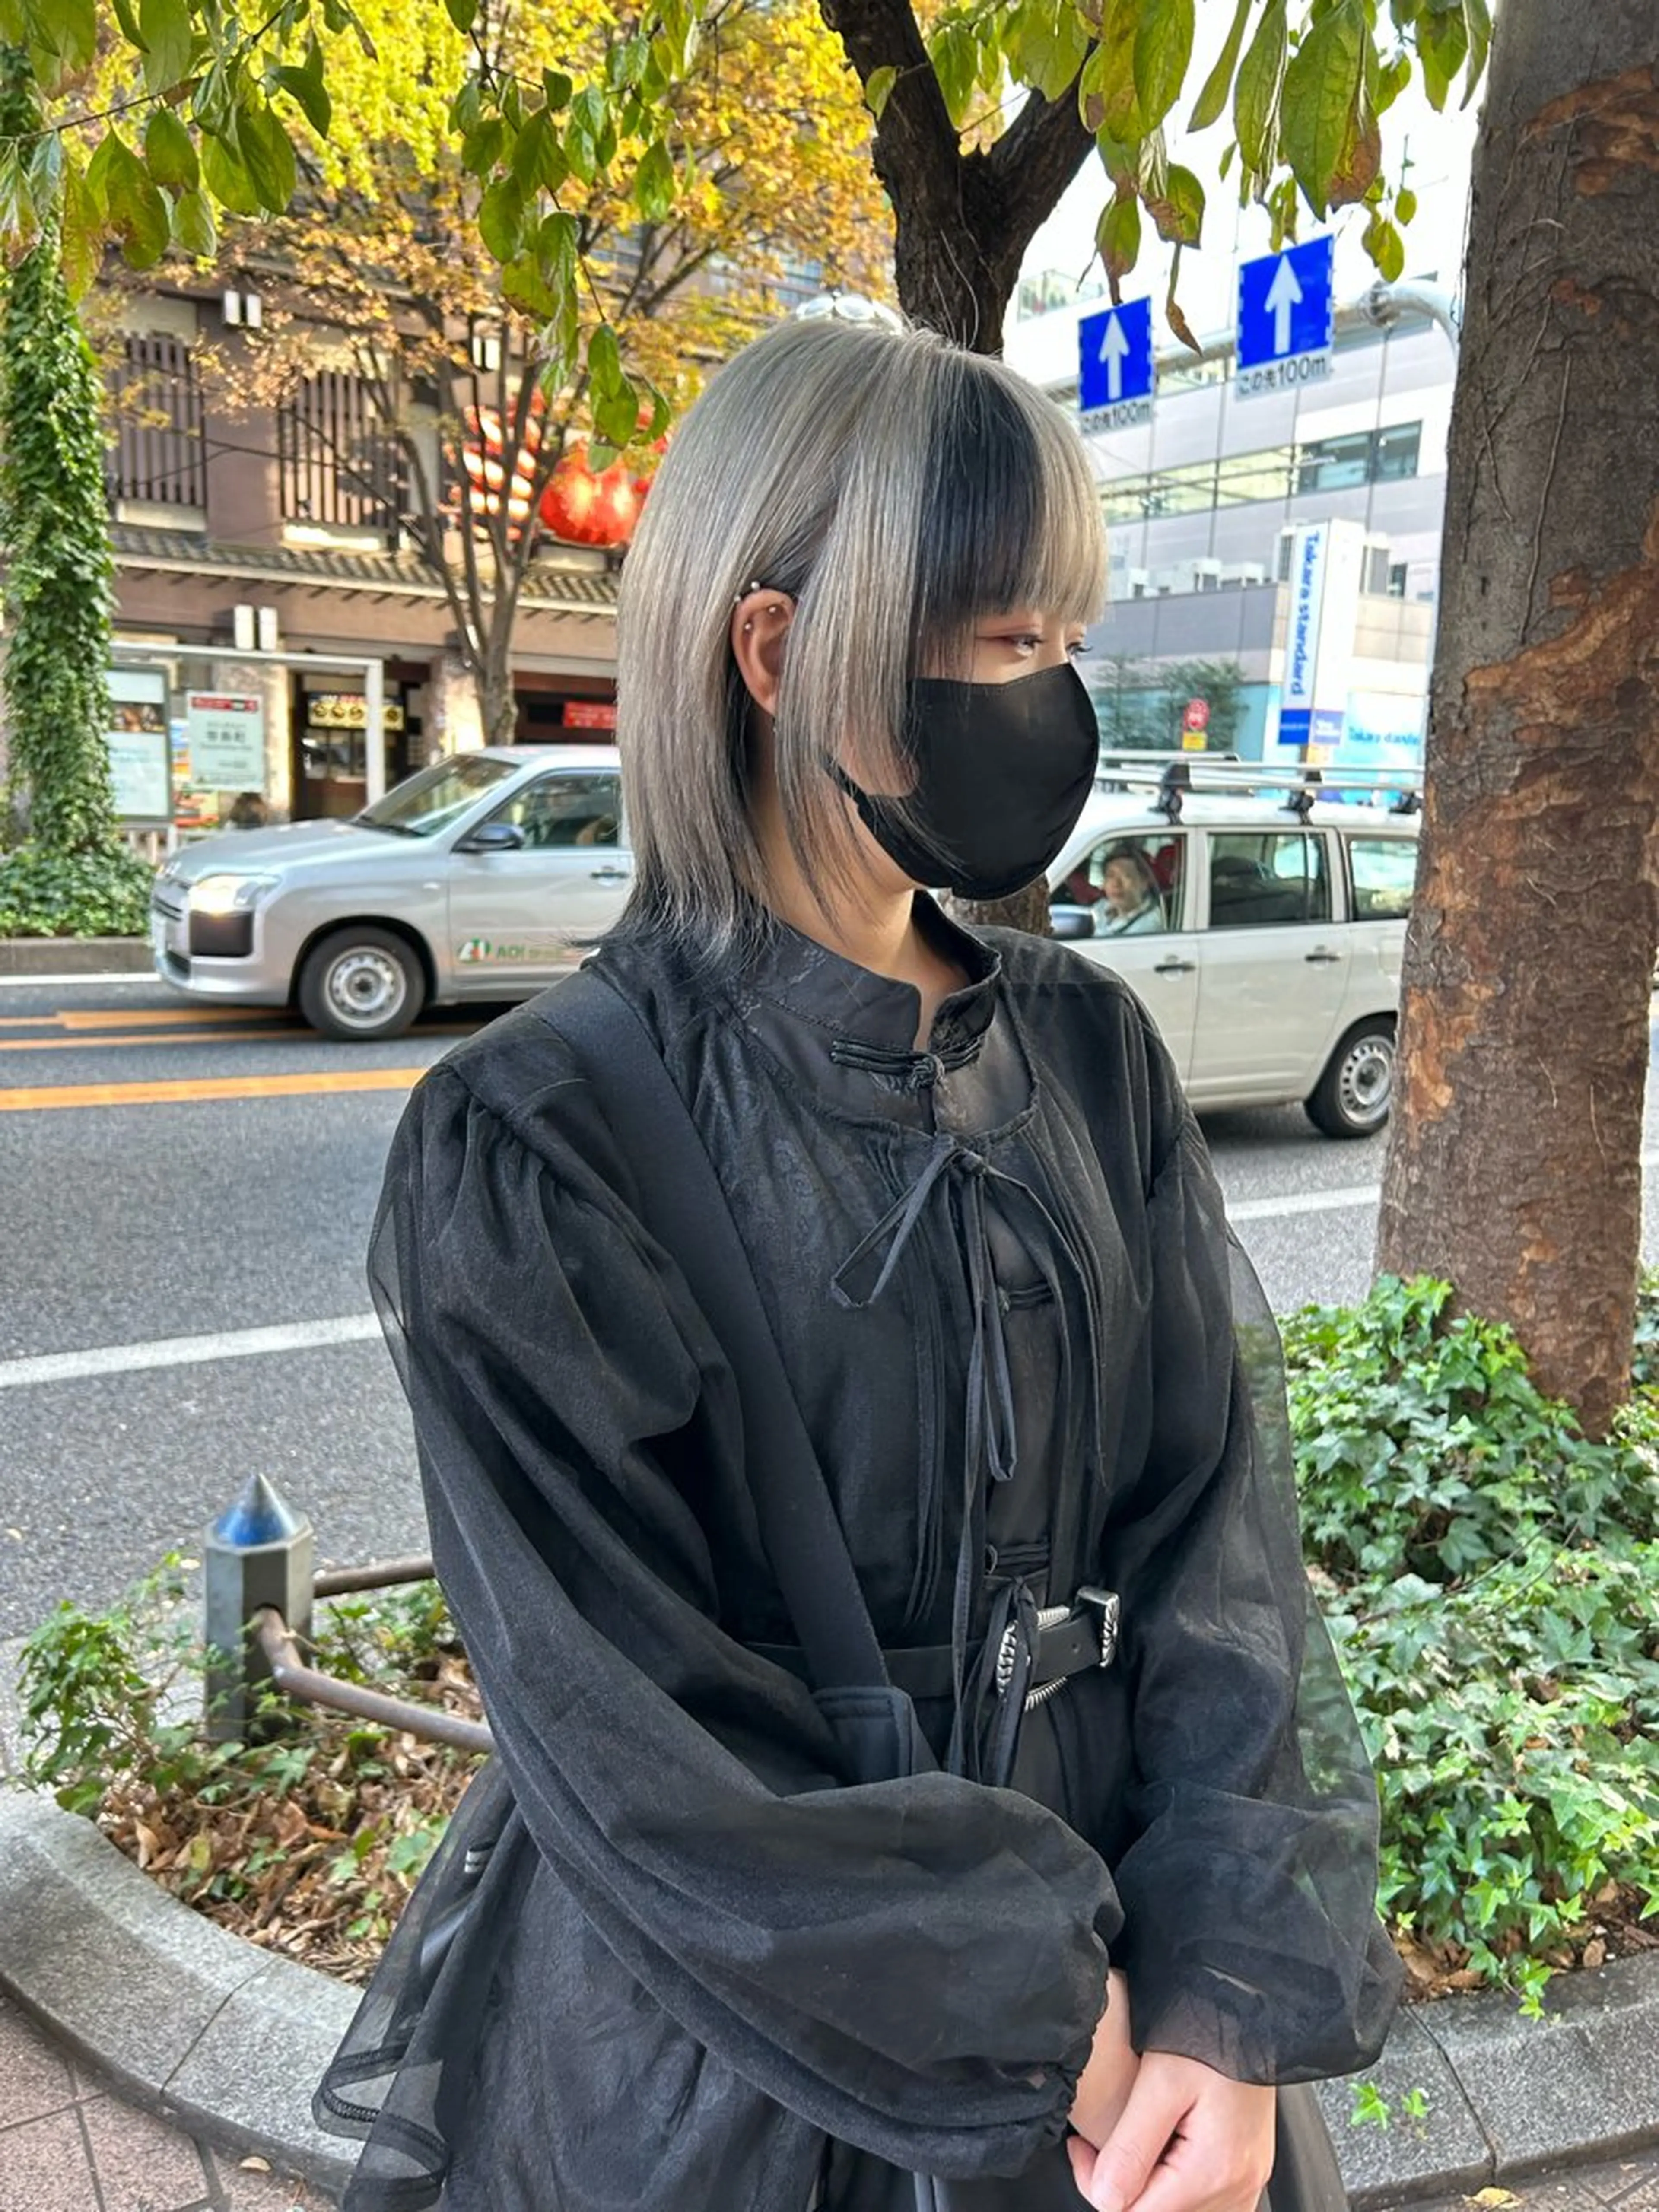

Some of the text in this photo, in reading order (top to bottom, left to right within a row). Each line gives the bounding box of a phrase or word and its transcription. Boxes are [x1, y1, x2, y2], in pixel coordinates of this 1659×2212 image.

[1239, 355, 1326, 395] この先100m
[1291, 531, 1319, 696] Takara standard
